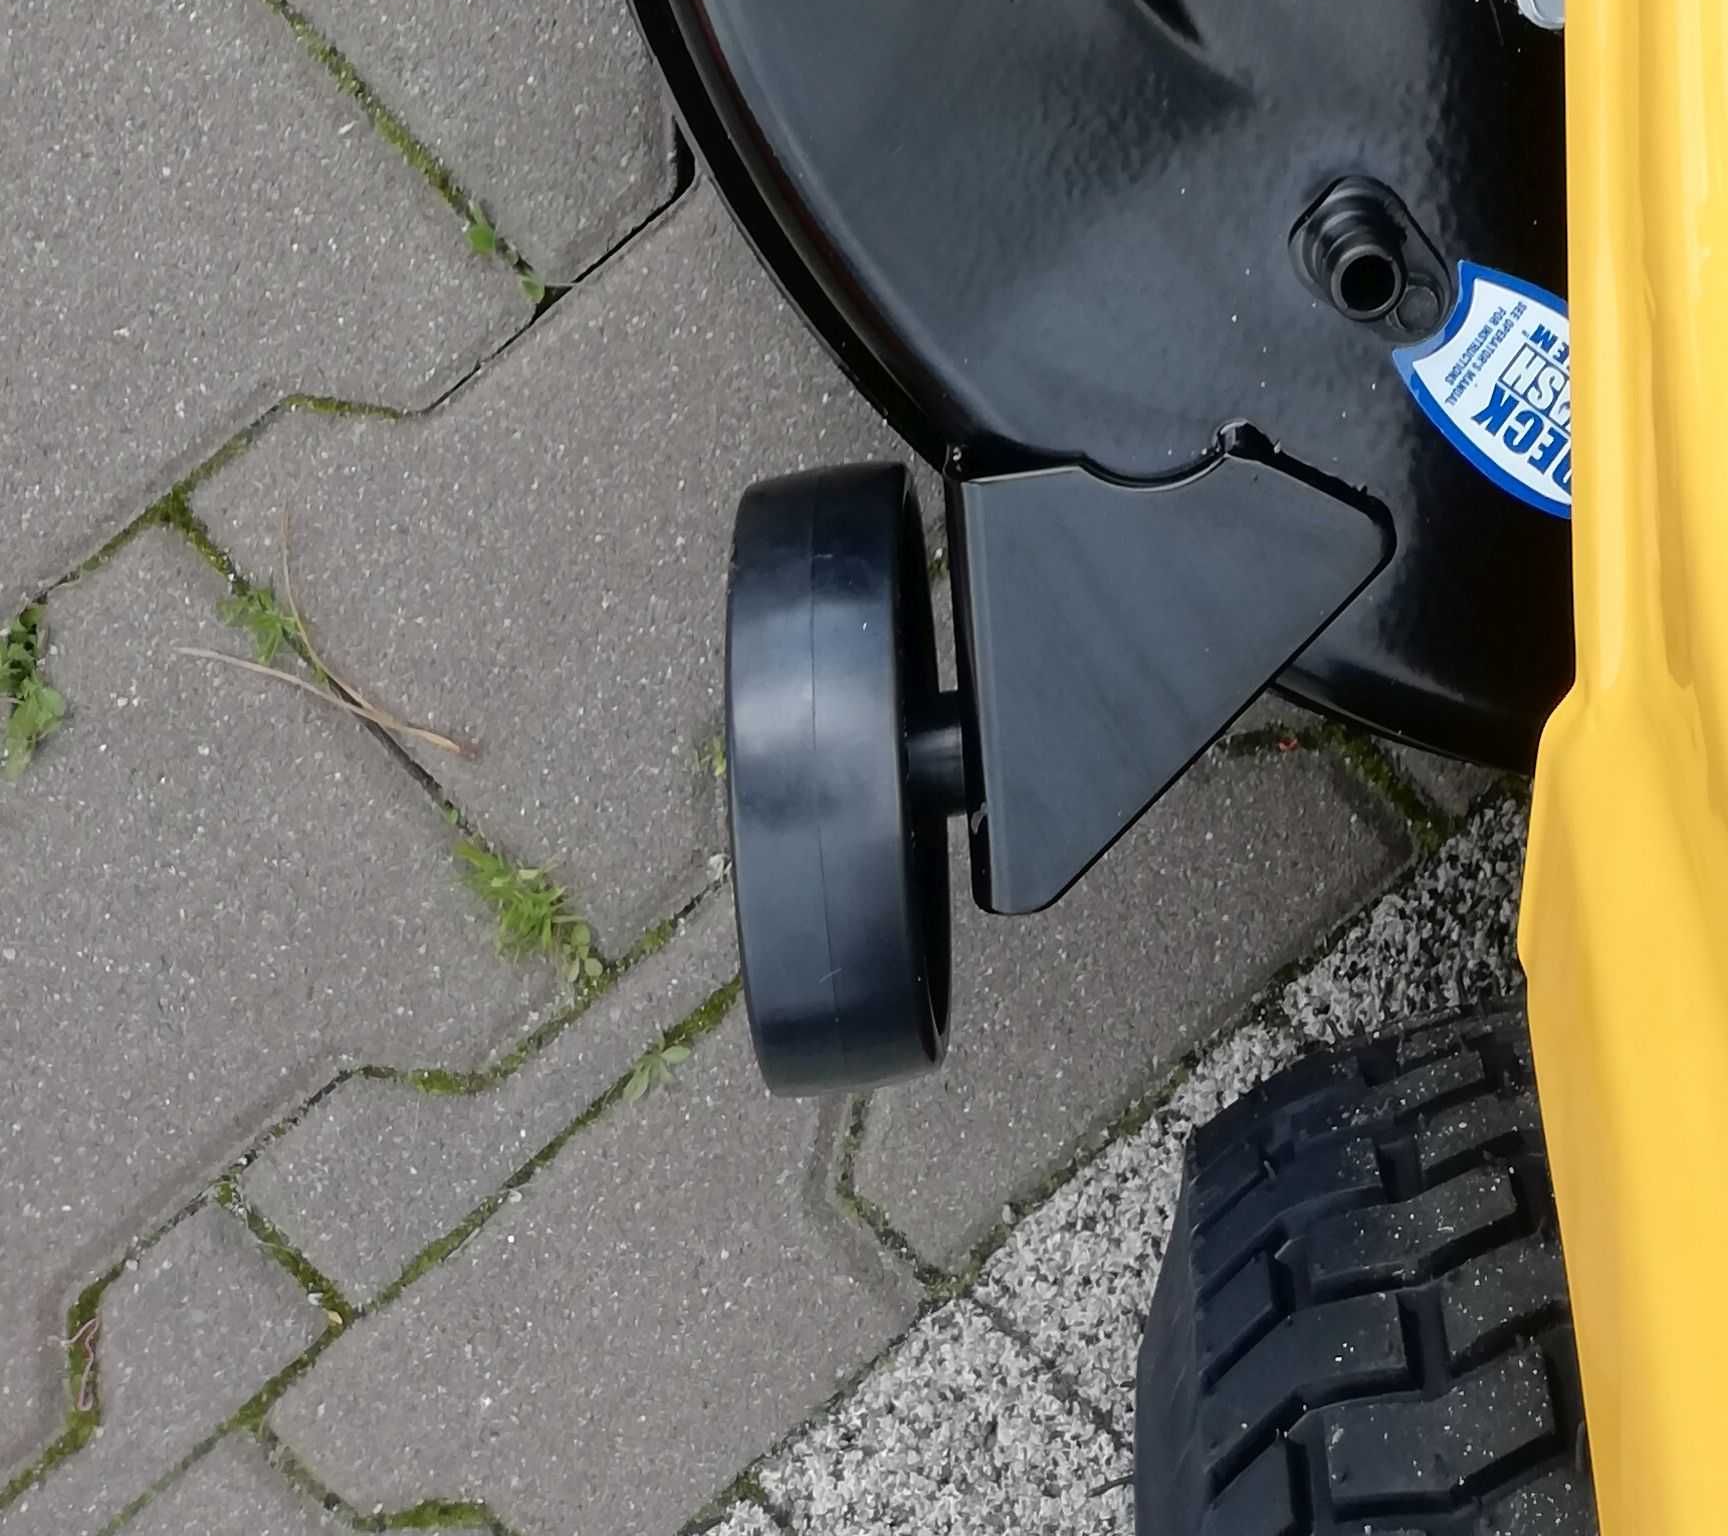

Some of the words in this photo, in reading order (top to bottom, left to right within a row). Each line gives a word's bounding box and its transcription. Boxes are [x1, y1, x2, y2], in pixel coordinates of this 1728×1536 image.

[1489, 306, 1506, 326] FOR
[1510, 301, 1527, 320] SEE
[1445, 324, 1493, 385] INSTRUCTIONS
[1472, 318, 1514, 371] OPERATOR'S
[1445, 370, 1476, 405] MANUAL
